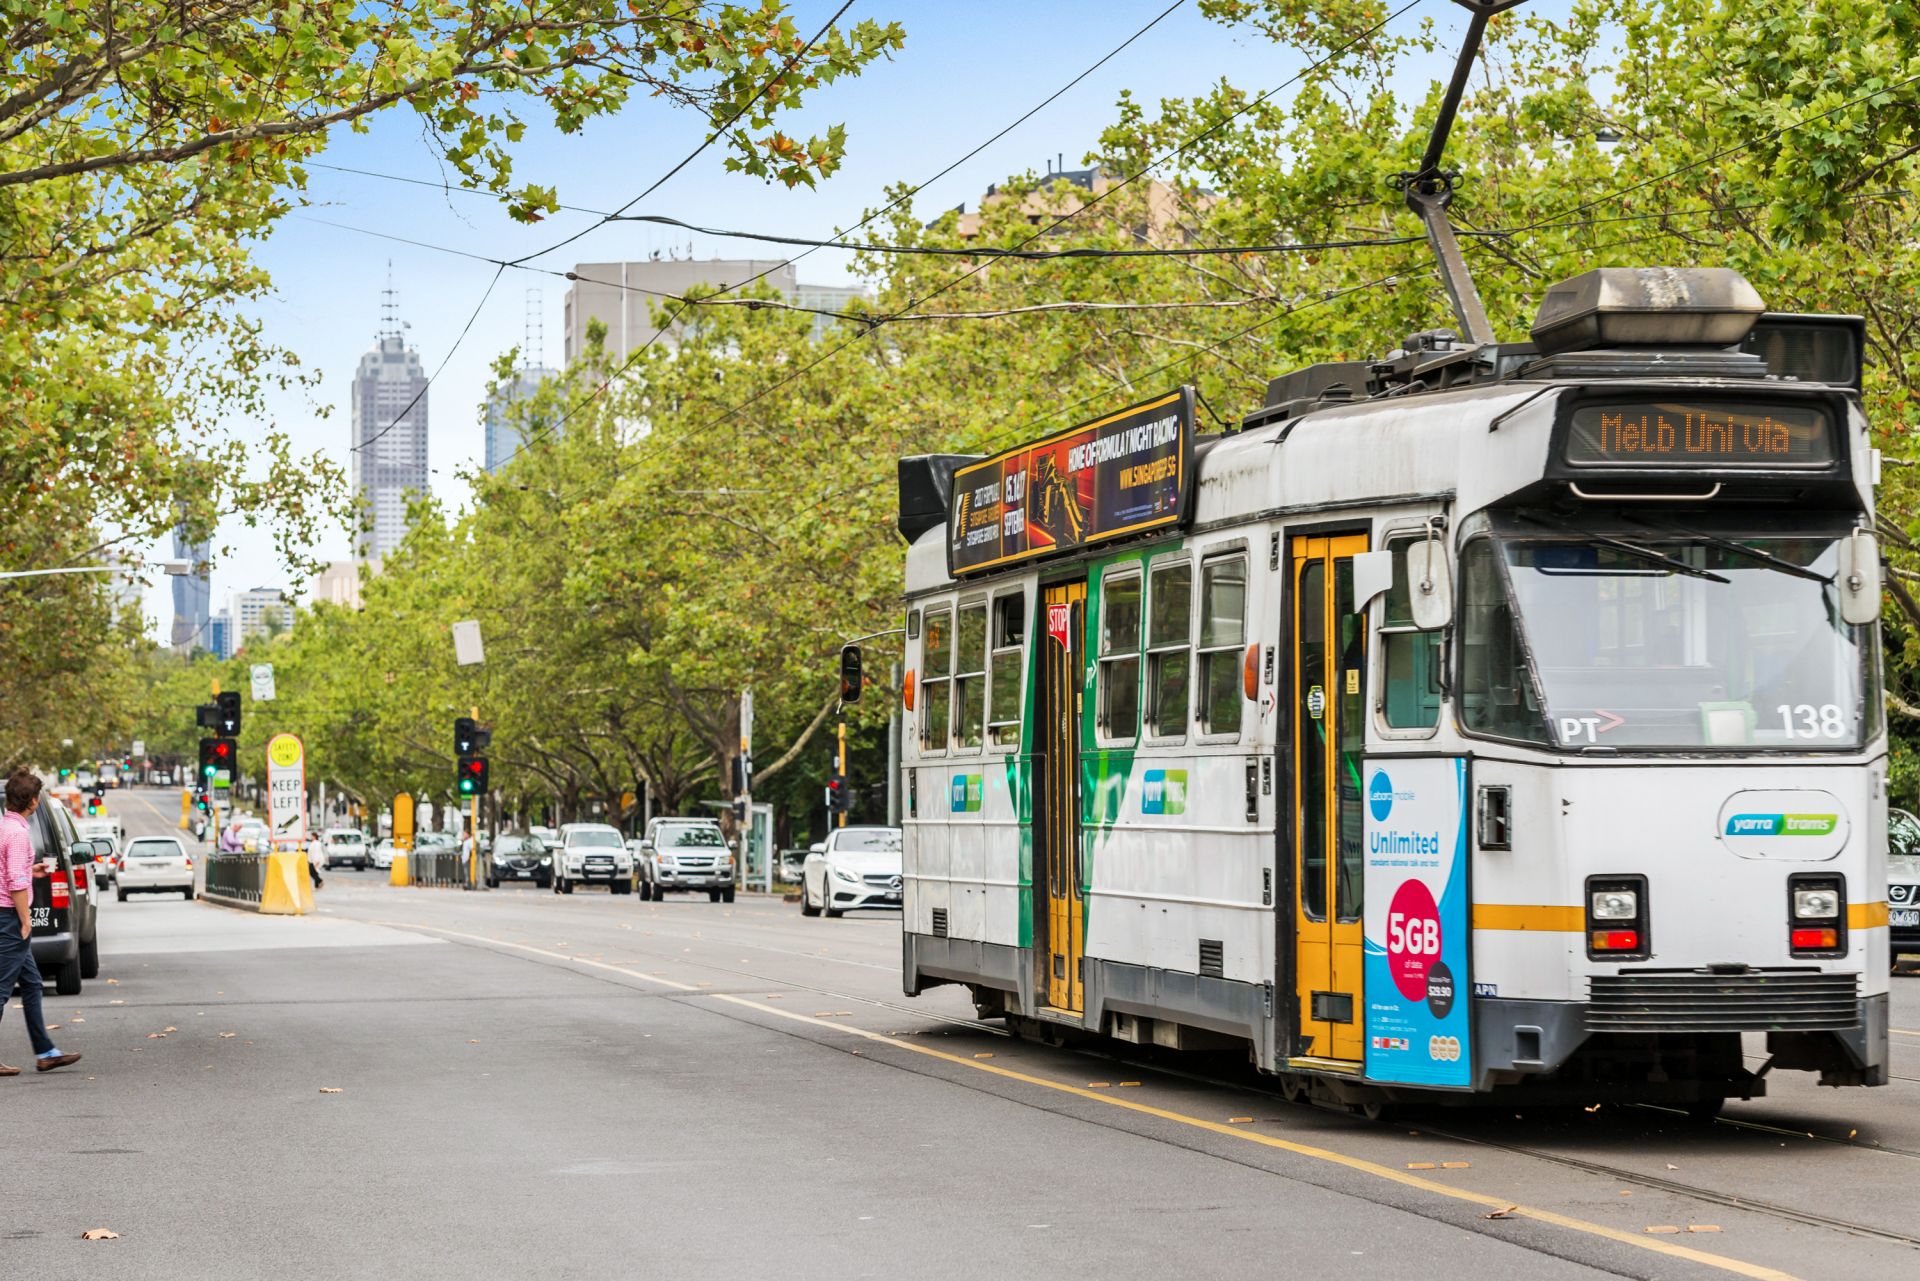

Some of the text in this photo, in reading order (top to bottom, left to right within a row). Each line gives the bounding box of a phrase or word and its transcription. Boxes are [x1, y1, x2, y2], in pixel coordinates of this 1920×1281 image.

[1601, 412, 1790, 453] Melb Uni via
[1085, 441, 1097, 468] OF
[1049, 608, 1067, 632] STOP
[1560, 718, 1600, 743] PT
[1777, 704, 1846, 740] 138
[272, 780, 301, 792] KEEP
[273, 797, 300, 809] LEFT
[1733, 815, 1830, 833] yarra trams
[1370, 831, 1439, 854] Unlimited
[31, 918, 49, 928] GINS
[33, 907, 51, 918] 787
[1389, 912, 1440, 955] 5GB
[1474, 984, 1496, 996] APN
